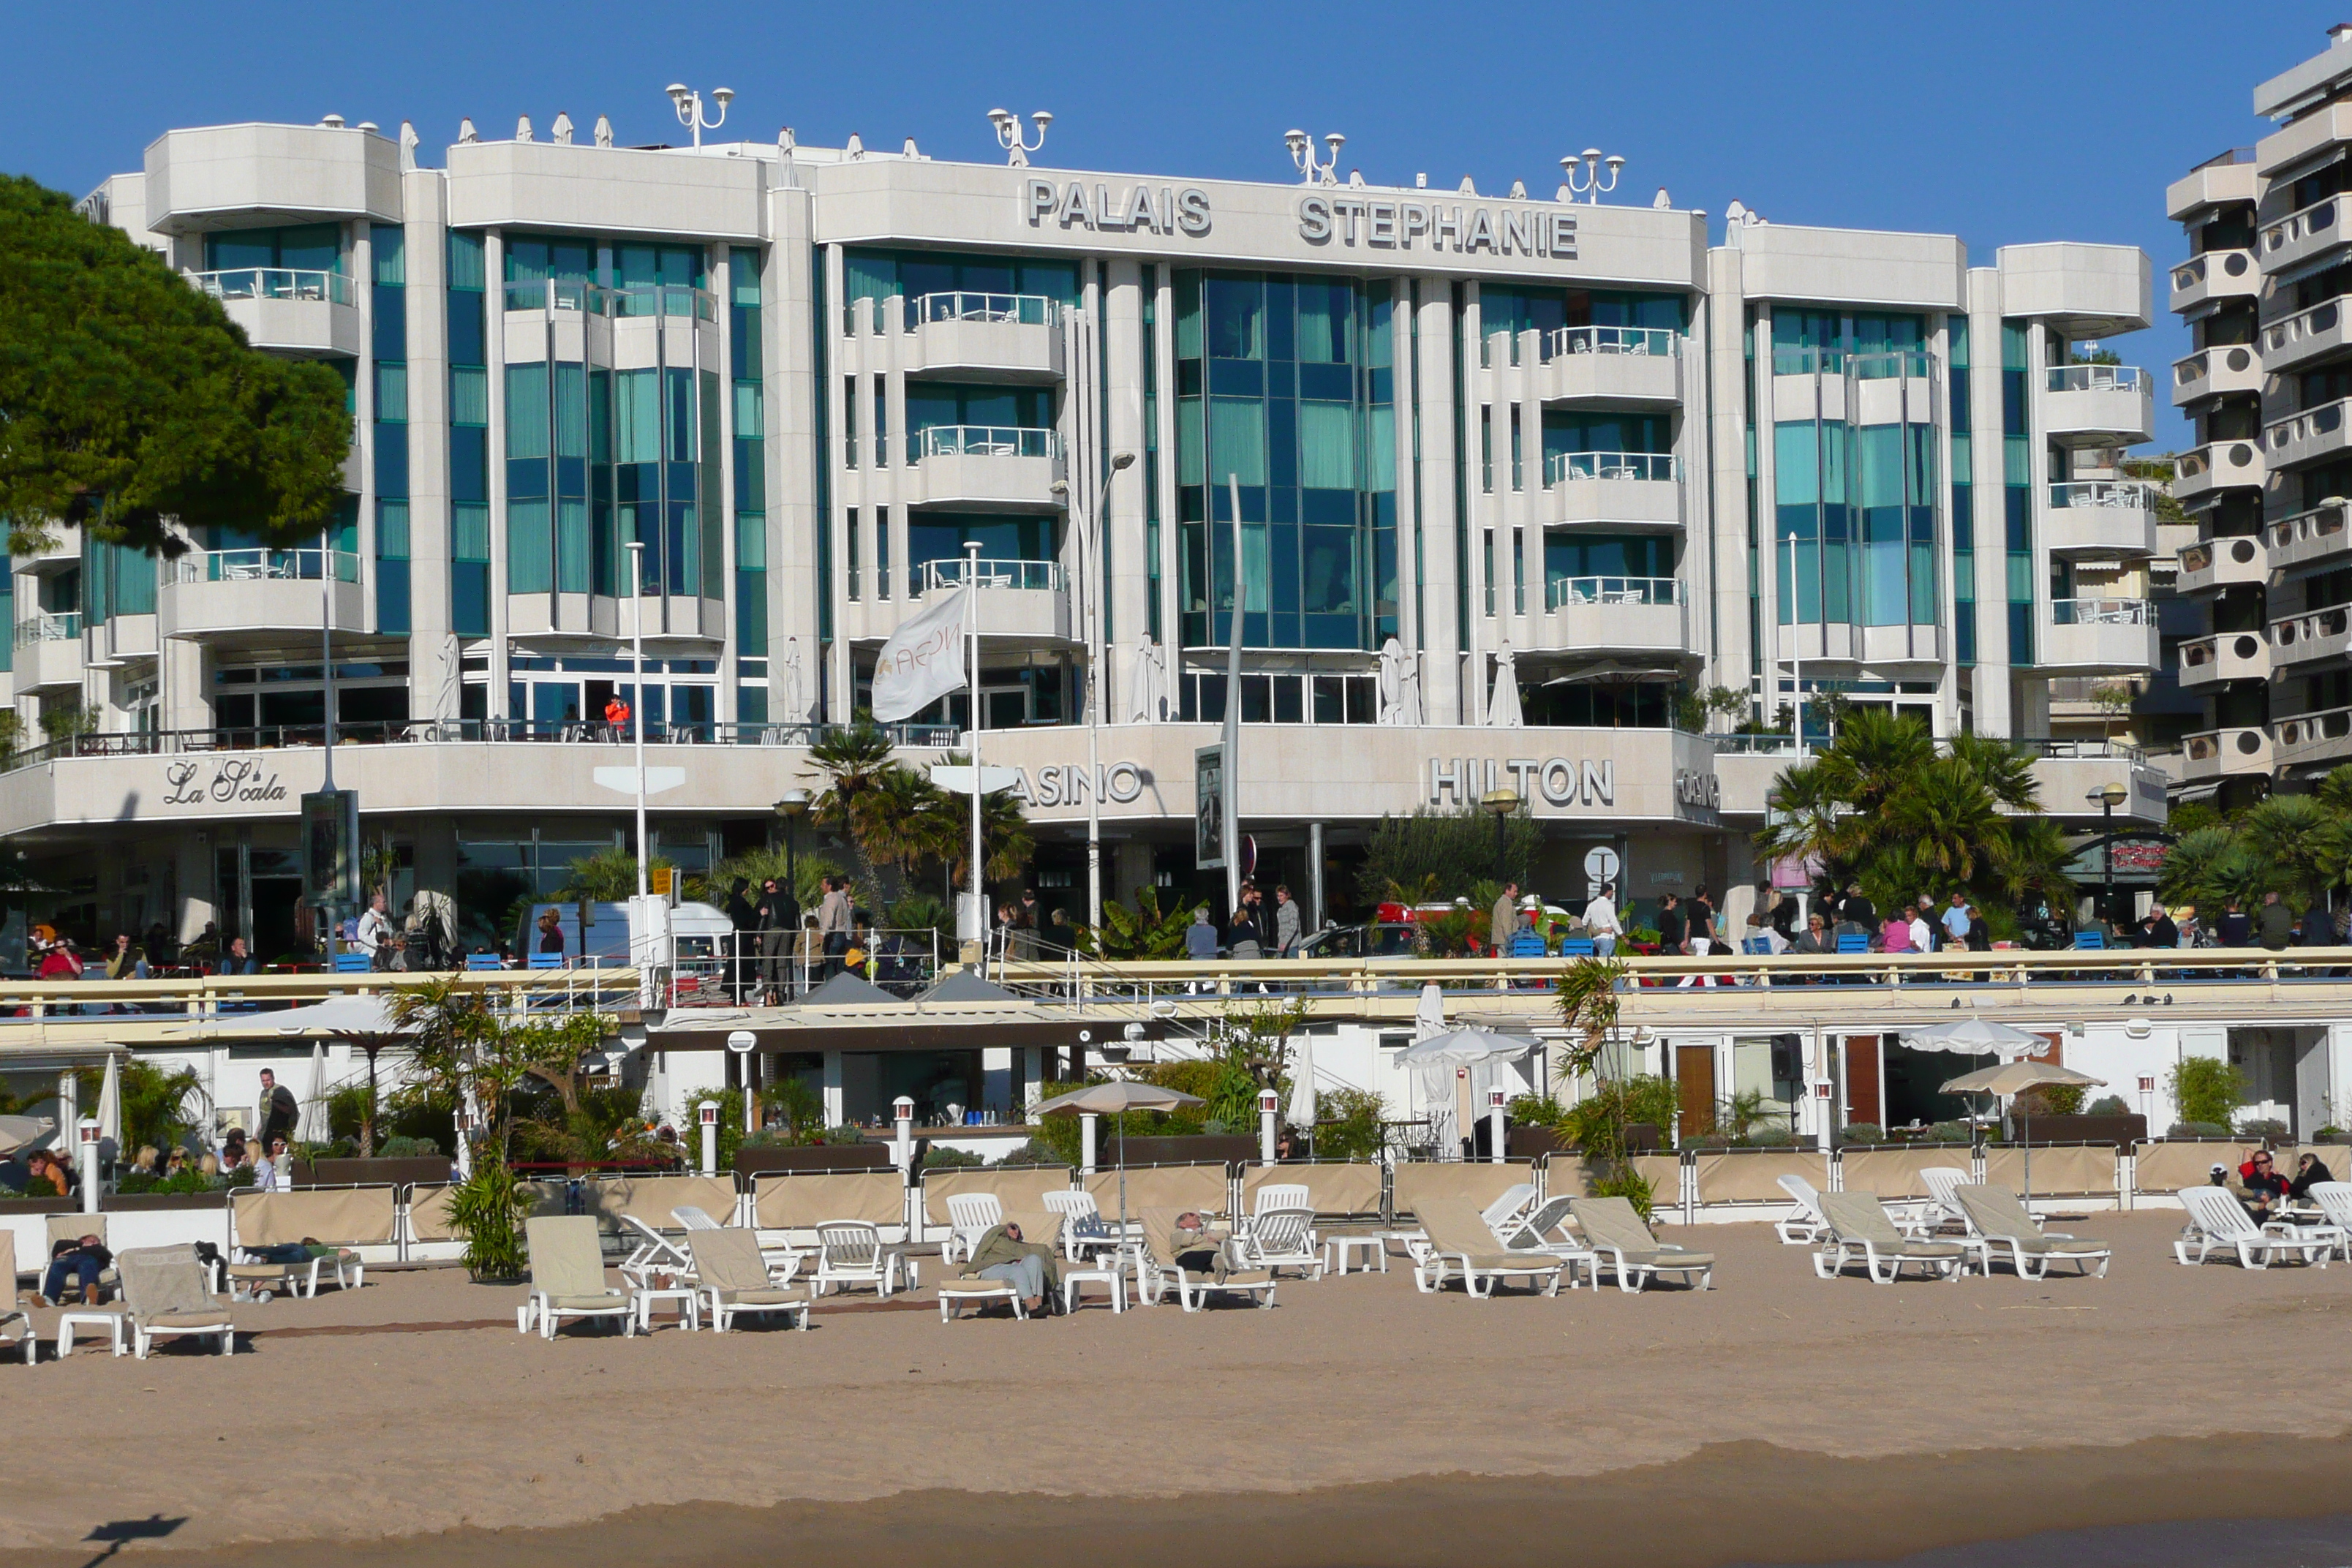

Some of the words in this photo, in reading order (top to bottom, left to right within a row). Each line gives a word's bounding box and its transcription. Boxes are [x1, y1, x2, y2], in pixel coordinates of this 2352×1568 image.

[1028, 178, 1211, 238] PALAIS
[1300, 196, 1579, 257] STEPHANIE
[163, 762, 206, 804] La
[211, 760, 287, 802] Scala
[1007, 761, 1144, 807] ASINO
[1429, 757, 1613, 807] HILTON
[1676, 768, 1721, 810] CASINO
